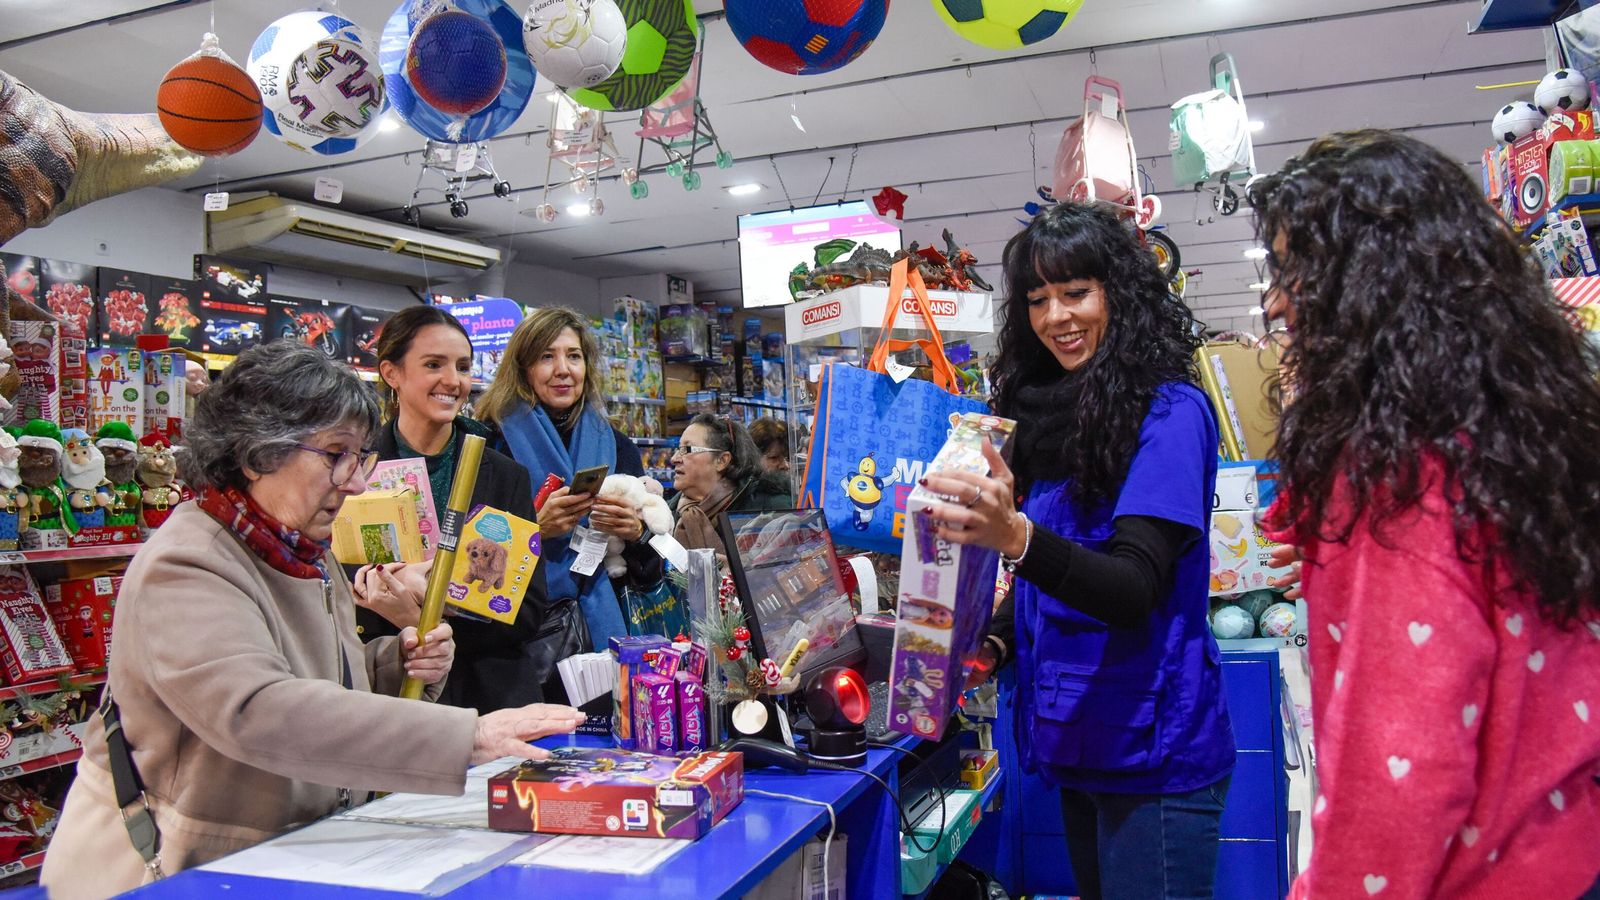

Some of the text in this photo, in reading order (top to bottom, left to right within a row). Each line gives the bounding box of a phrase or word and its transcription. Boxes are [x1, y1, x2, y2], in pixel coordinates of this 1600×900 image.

[1515, 144, 1543, 166] HITSTER
[803, 303, 840, 324] COMANSI
[903, 300, 954, 315] COANSI
[472, 317, 514, 333] planta
[19, 365, 51, 375] aughty
[2, 597, 34, 608] Naughty
[660, 706, 672, 747] LIGA
[687, 704, 699, 745] LIGA
